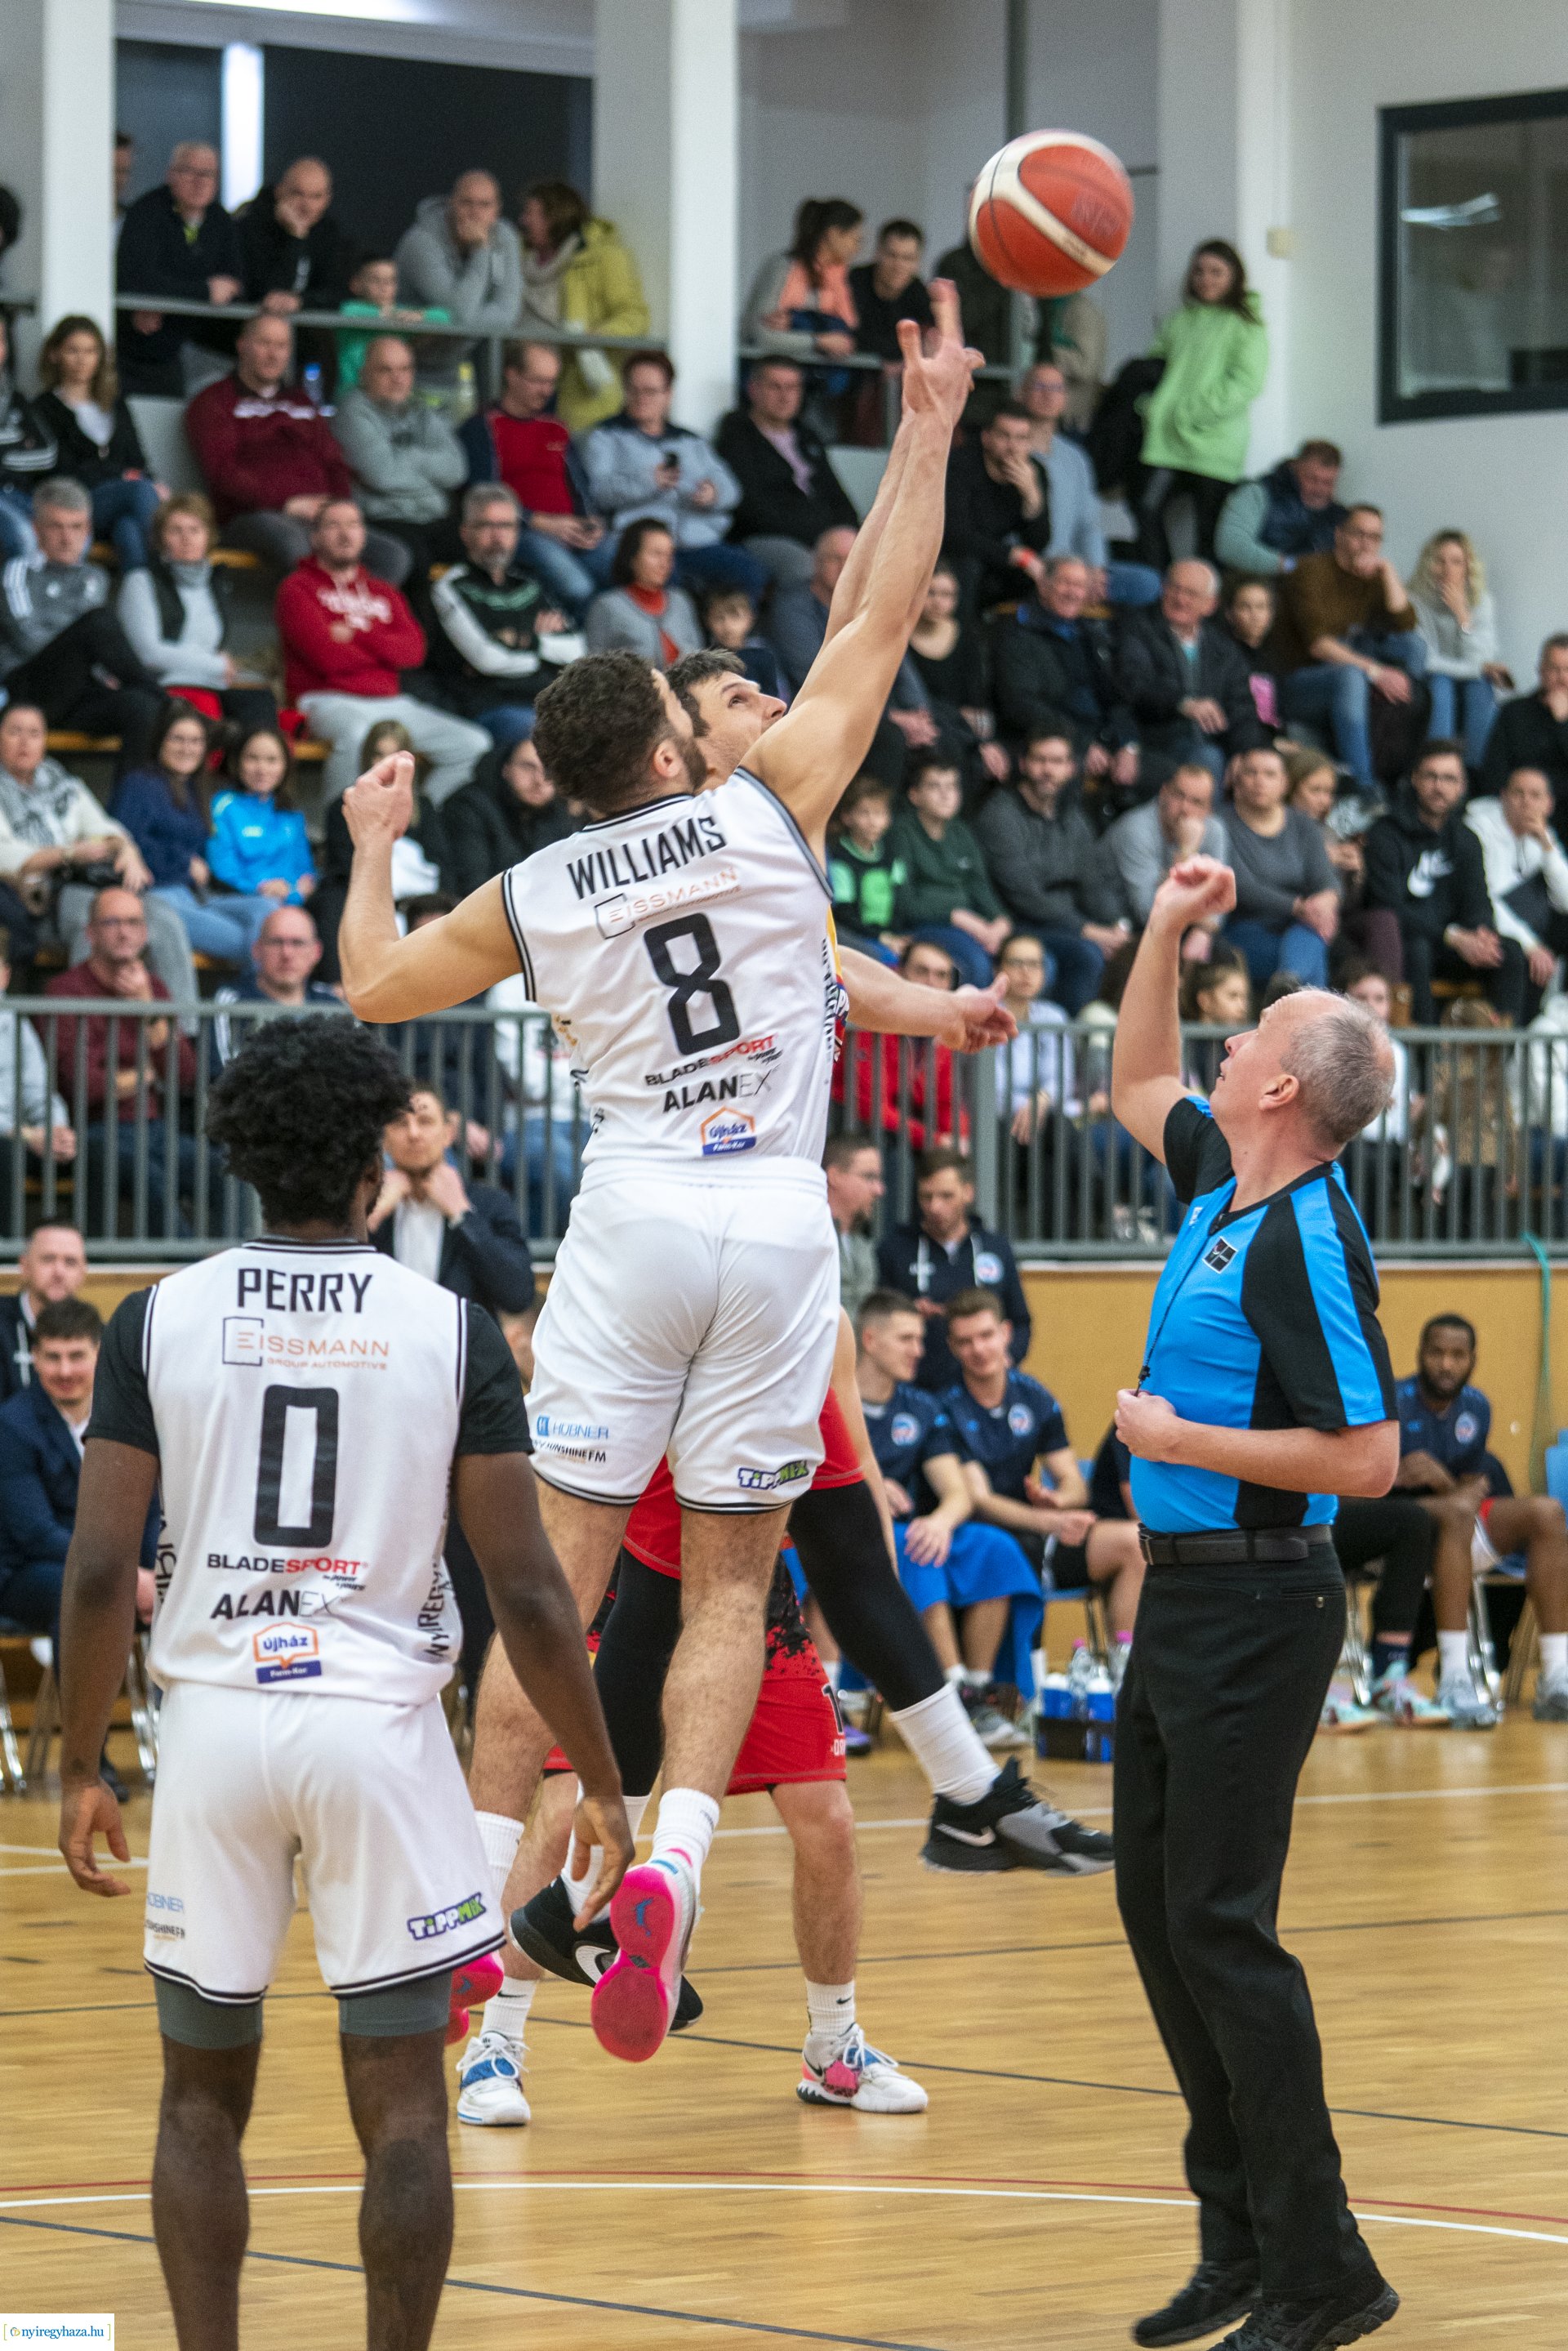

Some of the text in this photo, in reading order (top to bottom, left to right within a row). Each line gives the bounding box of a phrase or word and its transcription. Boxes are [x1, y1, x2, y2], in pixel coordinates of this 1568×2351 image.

[566, 816, 727, 900] WILLIAMS
[608, 866, 737, 924] EISSMANN
[643, 912, 741, 1056] 8
[644, 1034, 775, 1086] BLADESPORT
[662, 1068, 772, 1113] ALANEX
[237, 1267, 373, 1313] PERRY
[237, 1332, 390, 1357] EISSMANN
[253, 1384, 339, 1548] 0
[207, 1553, 360, 1576] BLADESPORT
